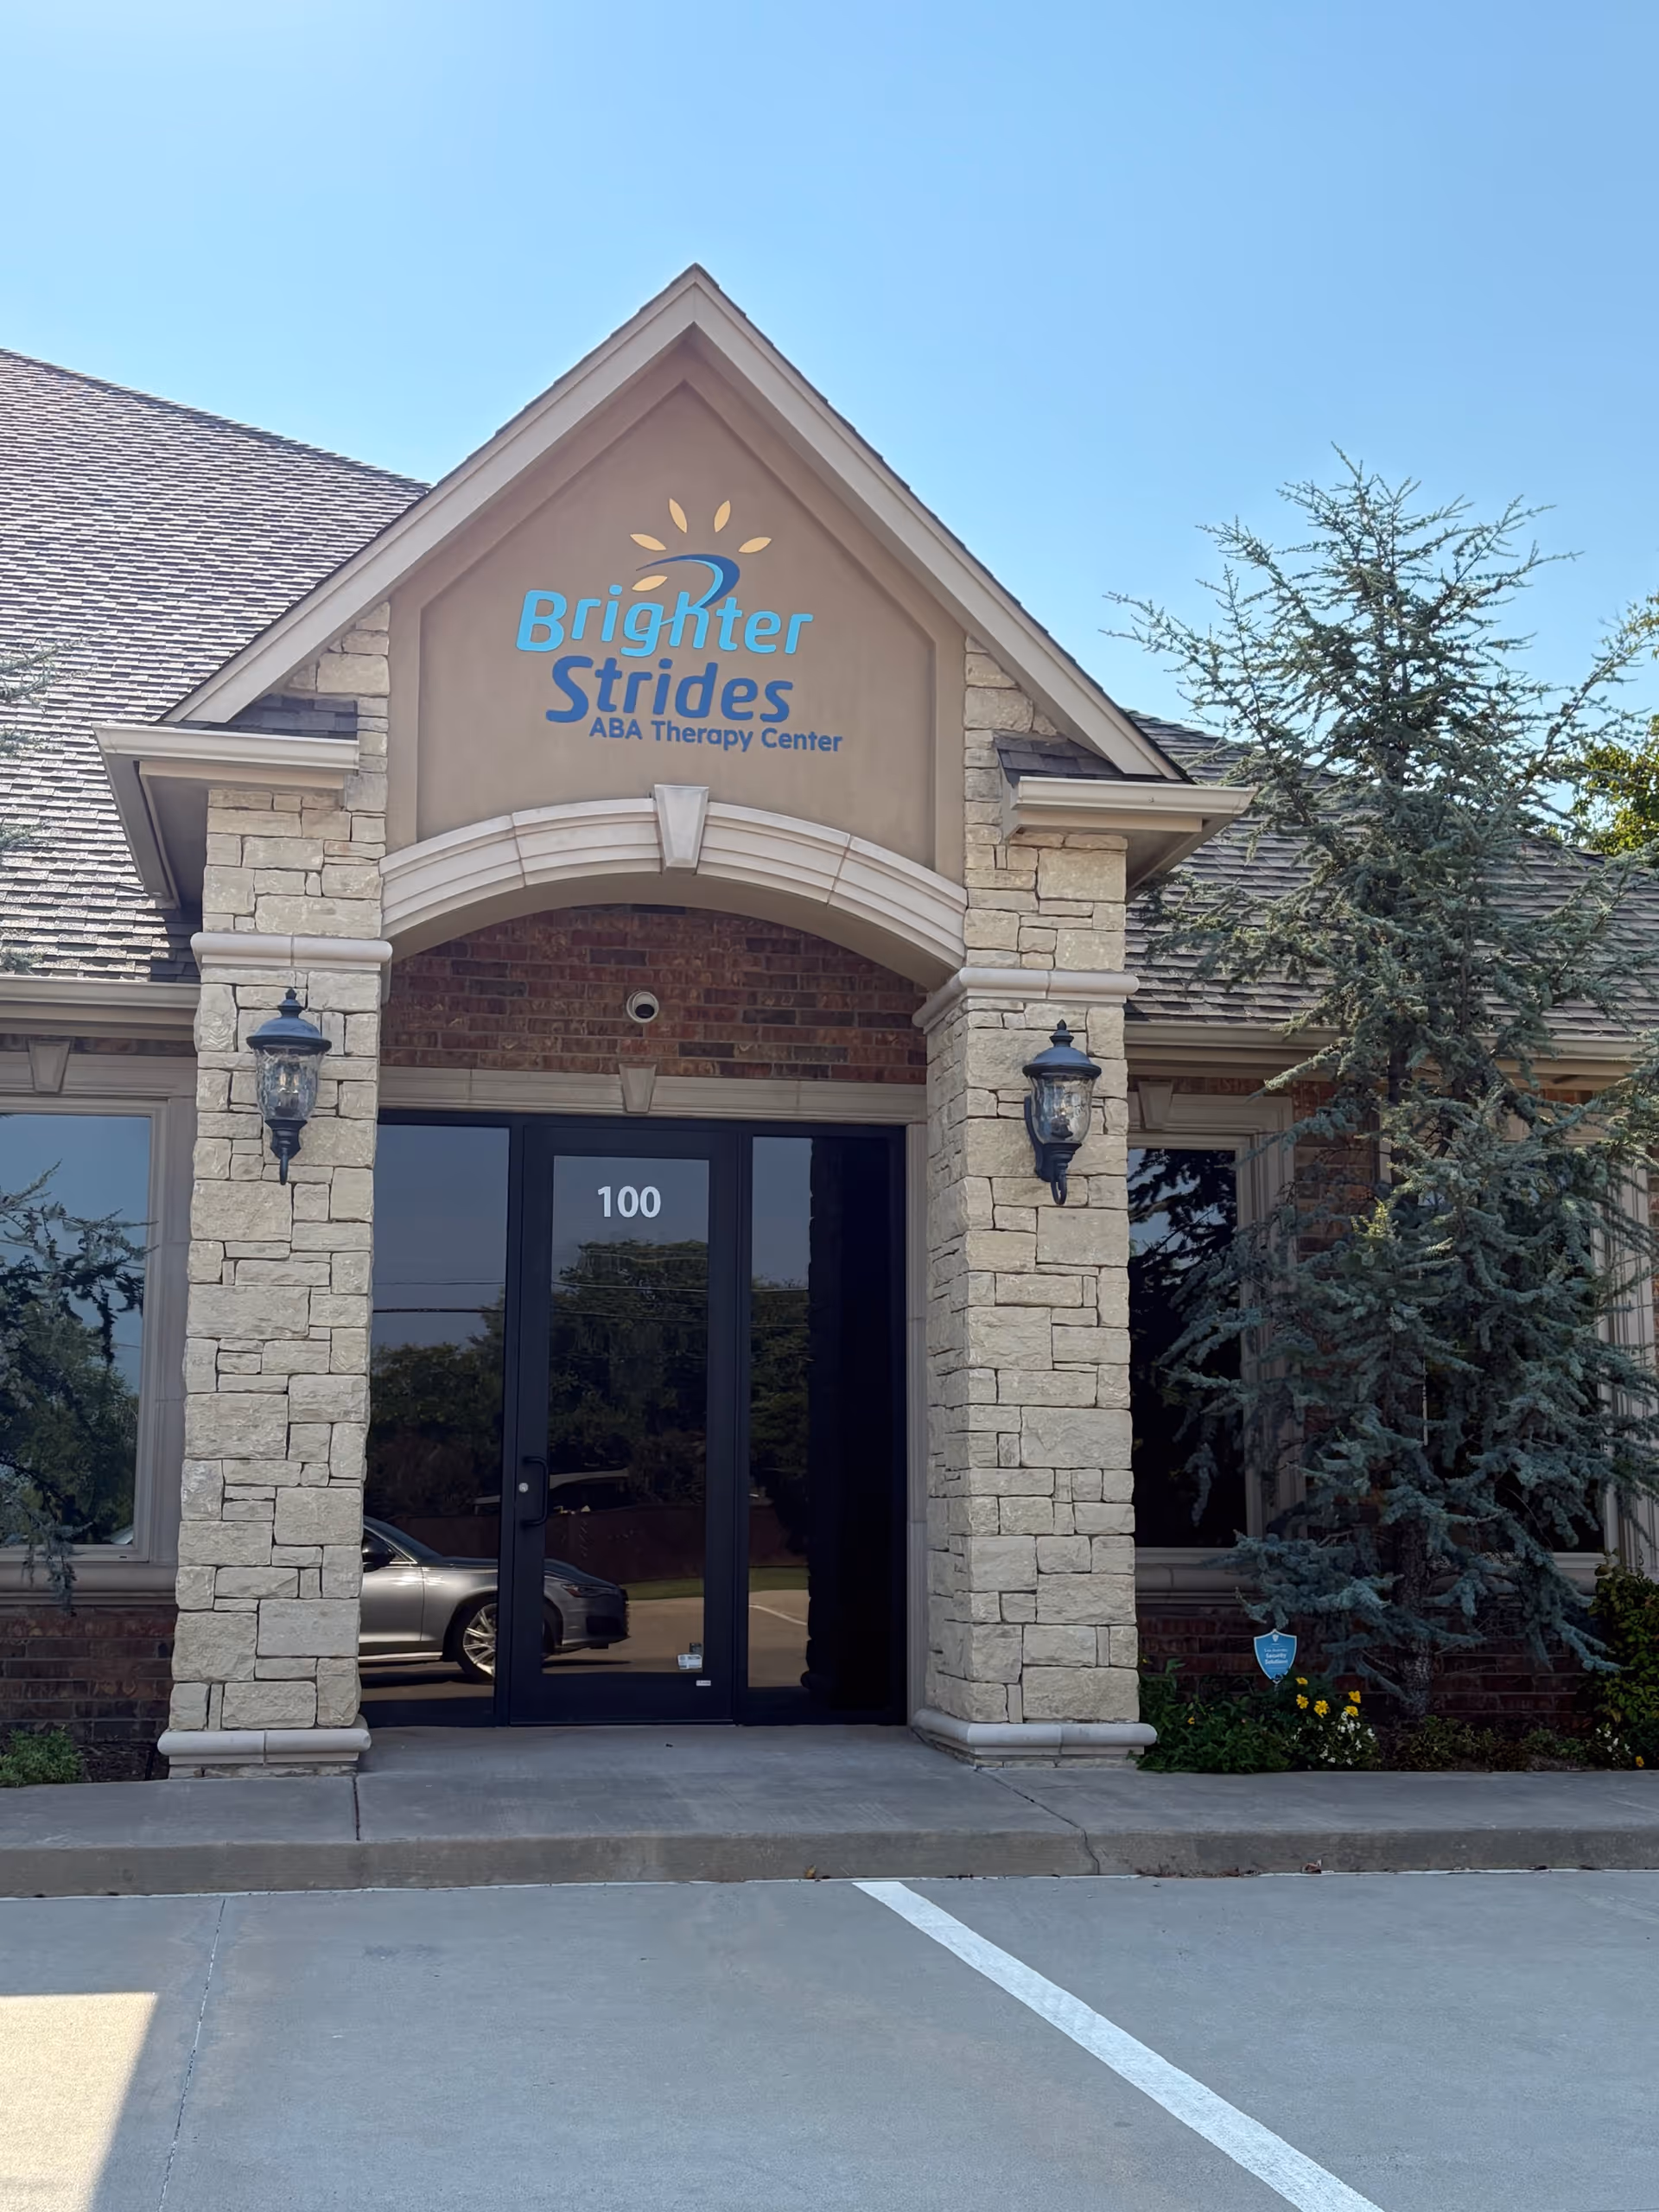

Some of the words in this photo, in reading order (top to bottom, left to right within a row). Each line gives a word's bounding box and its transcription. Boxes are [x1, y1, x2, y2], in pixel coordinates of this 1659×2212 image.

[516, 584, 814, 658] Brighter
[545, 655, 794, 723] Strides
[588, 716, 643, 741] ABA
[651, 720, 753, 753] Therapy
[761, 727, 843, 752] Center
[597, 1185, 661, 1218] 100
